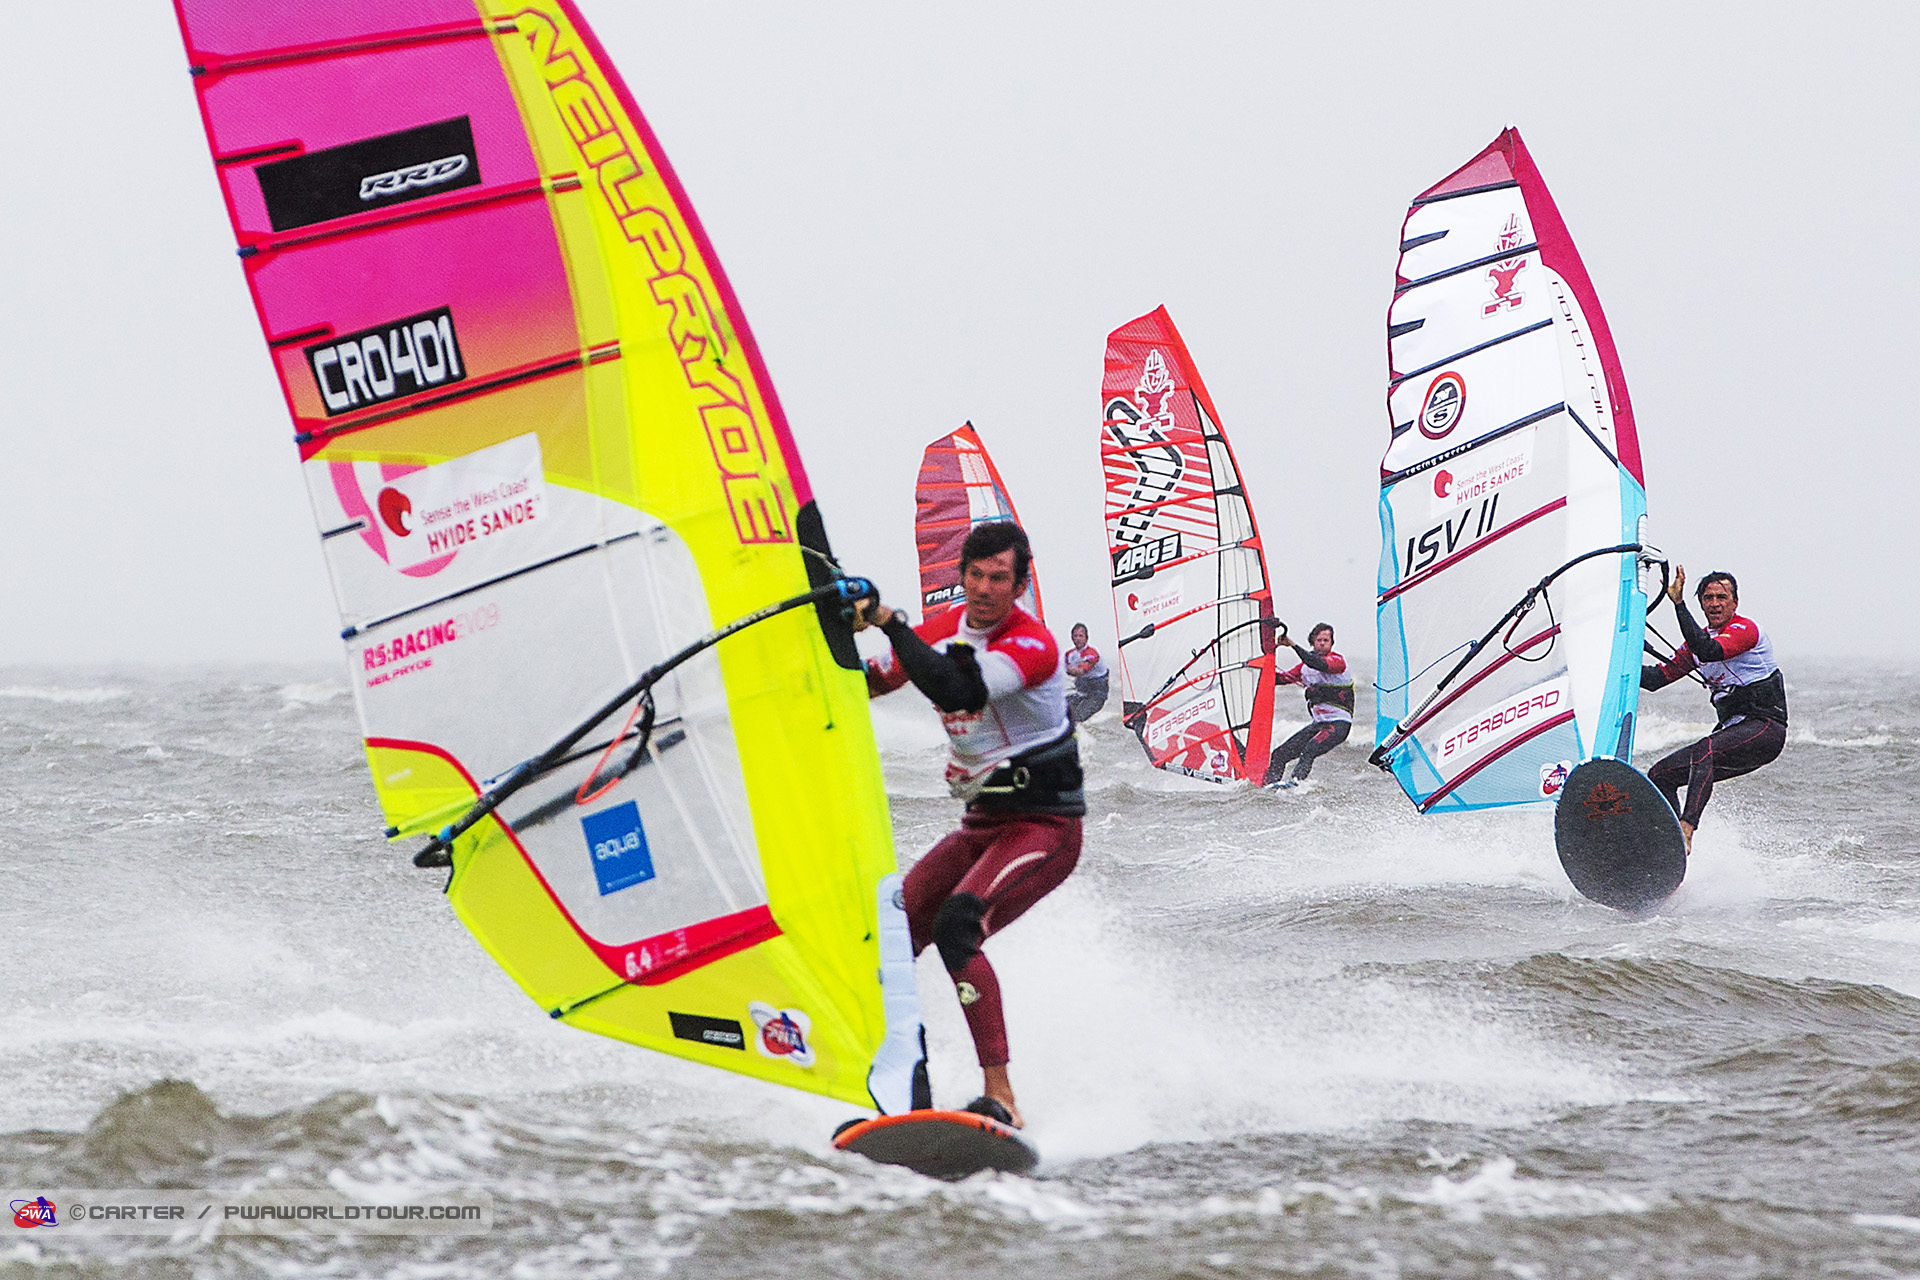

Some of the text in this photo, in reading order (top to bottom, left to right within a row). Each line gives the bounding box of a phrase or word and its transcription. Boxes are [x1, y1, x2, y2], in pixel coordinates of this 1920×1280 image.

[359, 154, 469, 200] RRD
[516, 8, 794, 545] NEILPRYDE
[1405, 458, 1437, 477] racing
[1456, 453, 1524, 490] Sense the West Coast
[1456, 463, 1525, 506] HVIDE SANDE
[419, 477, 529, 526] Sense the West Coast
[427, 499, 536, 554] HVIDE SANDE
[1403, 508, 1472, 579] ISV
[1115, 534, 1180, 576] ARG 3
[1152, 697, 1216, 740] STARBOARD
[1443, 690, 1560, 757] STARBOARD
[595, 831, 641, 862] aqua
